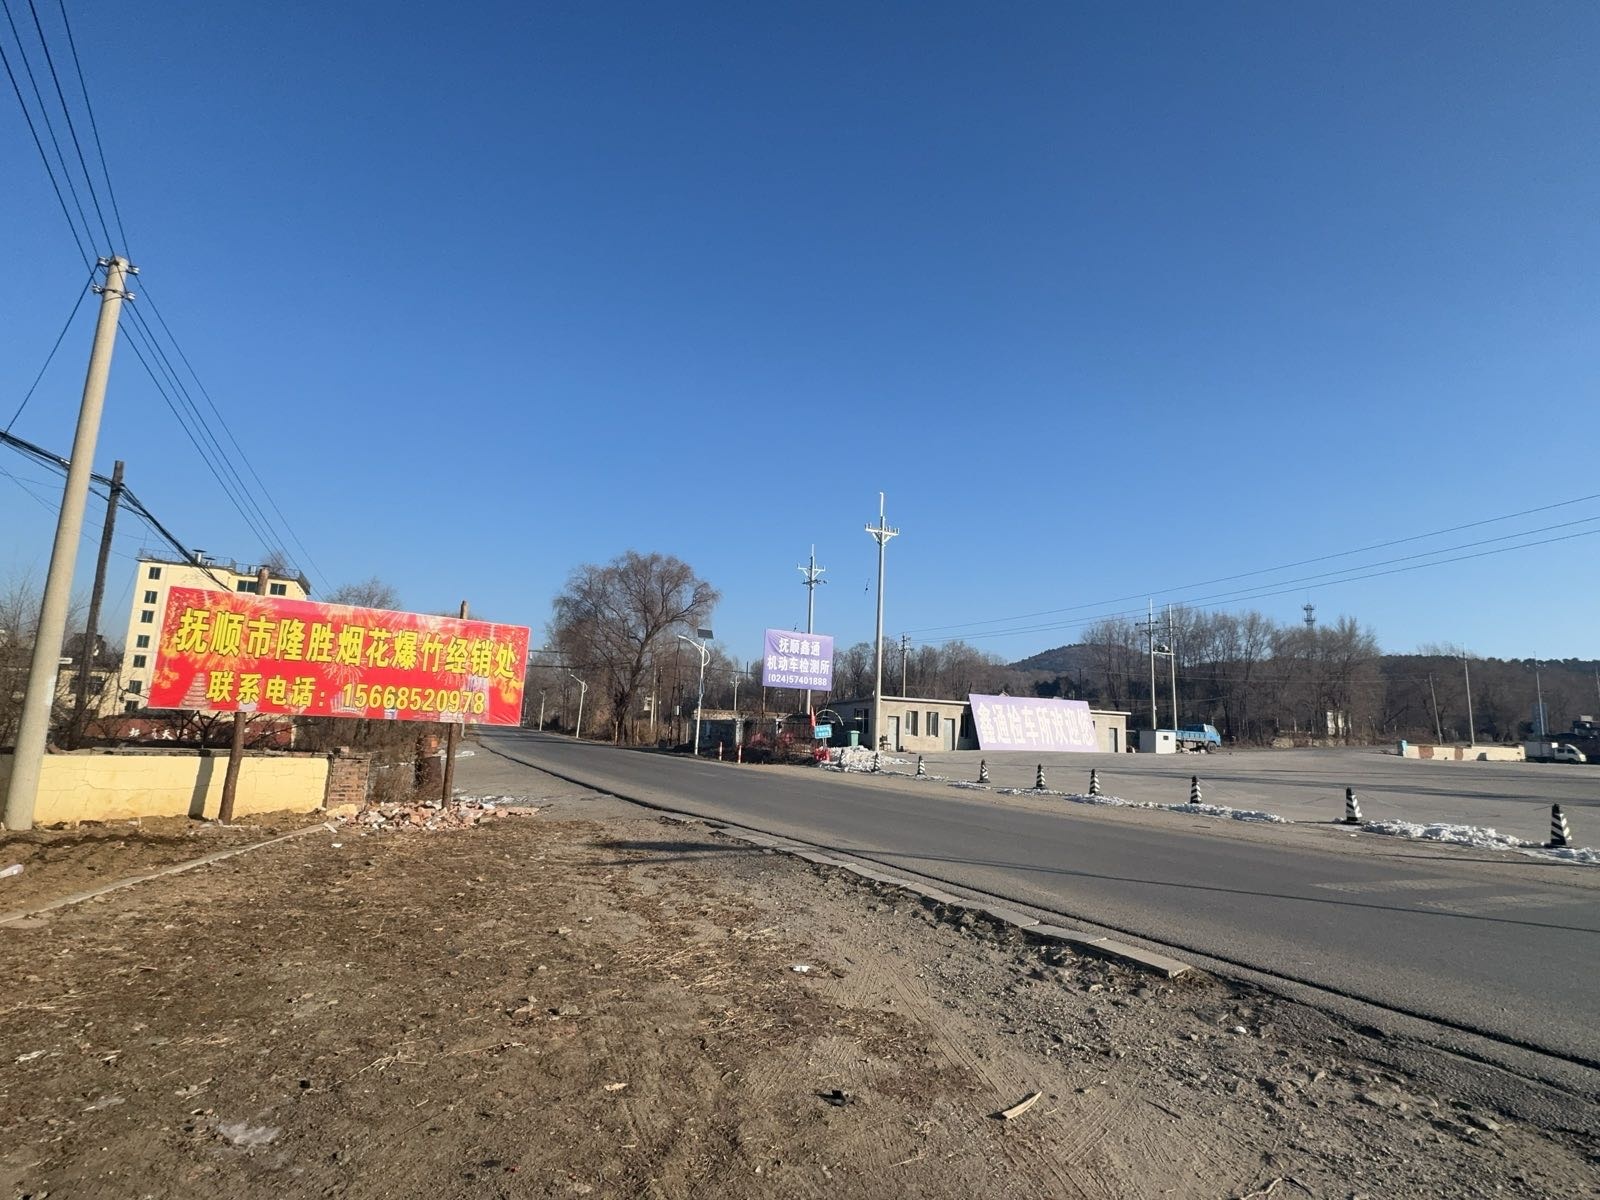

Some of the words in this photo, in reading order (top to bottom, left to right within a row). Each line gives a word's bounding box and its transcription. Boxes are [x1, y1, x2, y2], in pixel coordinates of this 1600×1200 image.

[177, 607, 517, 679] 抚顺市隆胜烟花爆竹经销处
[778, 637, 820, 656] 抚顺鑫通
[767, 655, 830, 675] 机动车检测所
[768, 673, 828, 686] (024)57401888
[977, 701, 1095, 746] 鑫通检车所欢迎您
